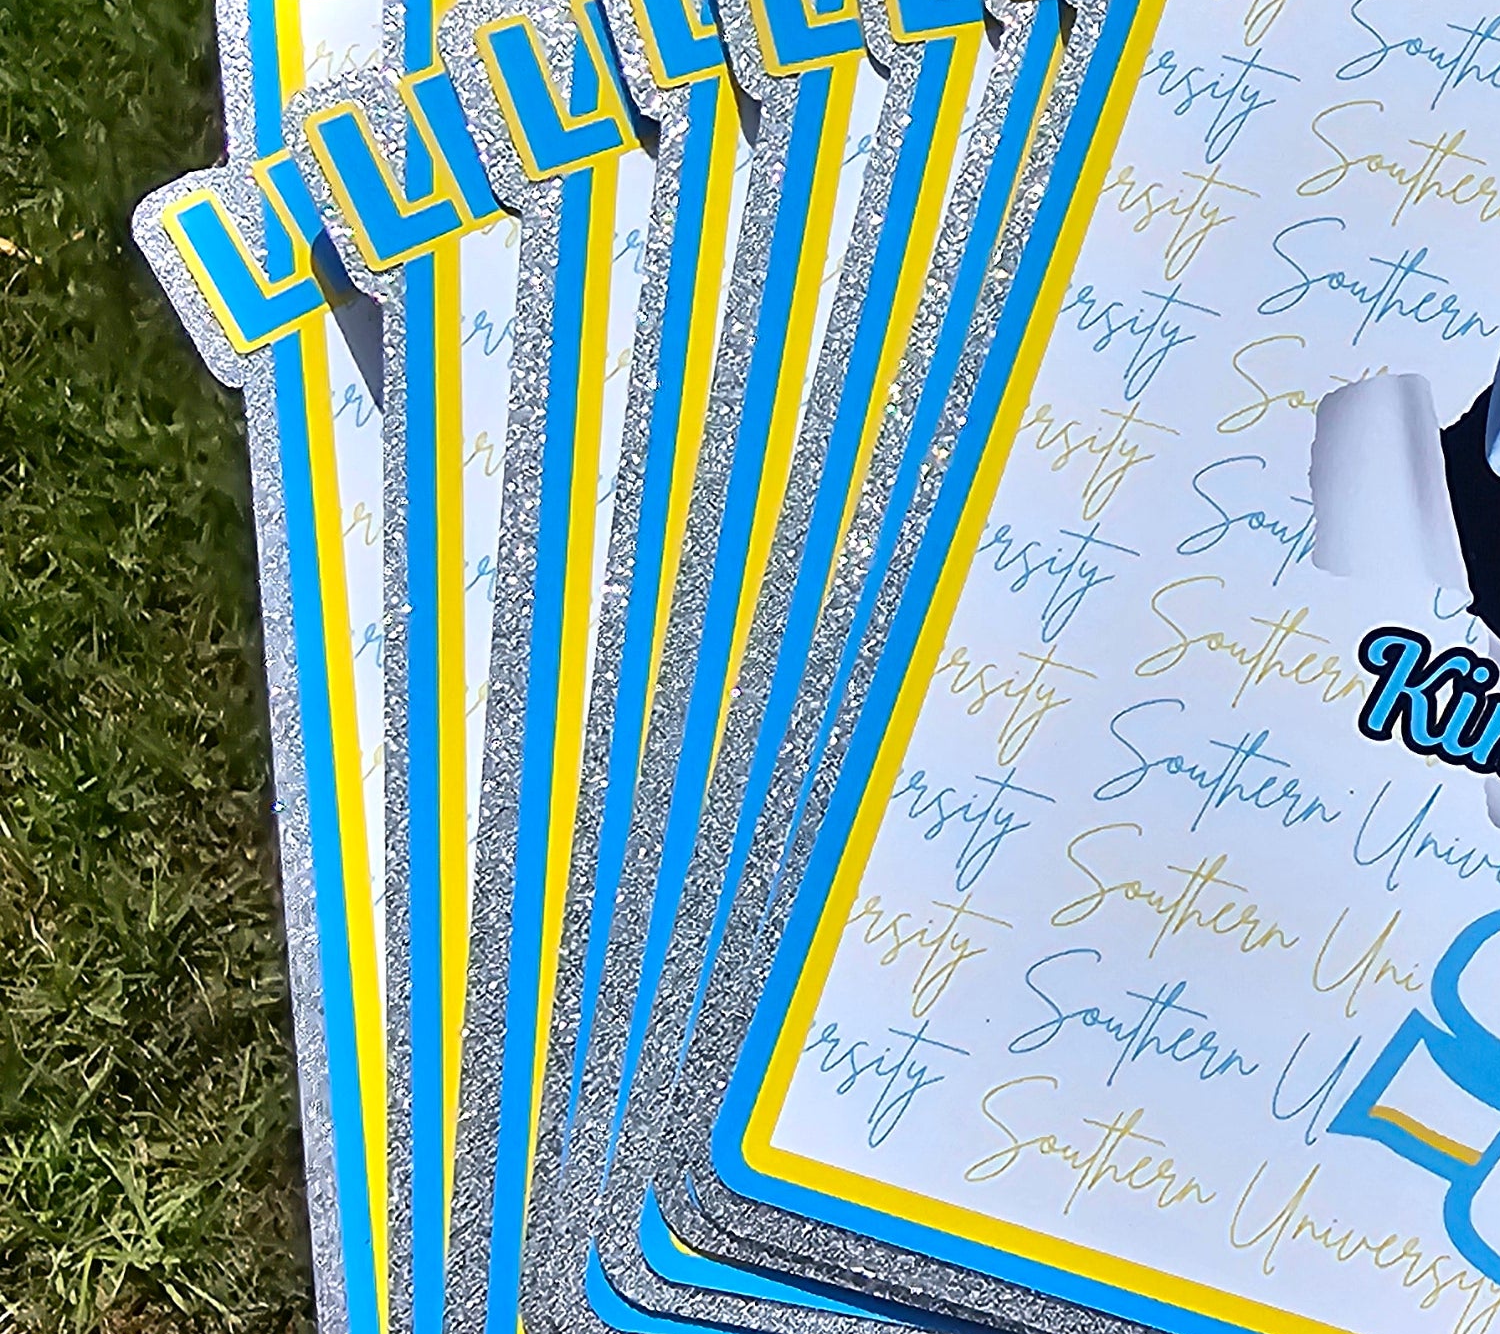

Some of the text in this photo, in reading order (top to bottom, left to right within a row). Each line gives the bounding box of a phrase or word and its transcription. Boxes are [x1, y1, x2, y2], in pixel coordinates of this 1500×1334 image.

[1258, 217, 1500, 346] Southern
[1094, 698, 1342, 832] Southern
[1050, 822, 1300, 959] Southern
[1008, 948, 1259, 1087] Southern
[964, 1076, 1217, 1215] Southern
